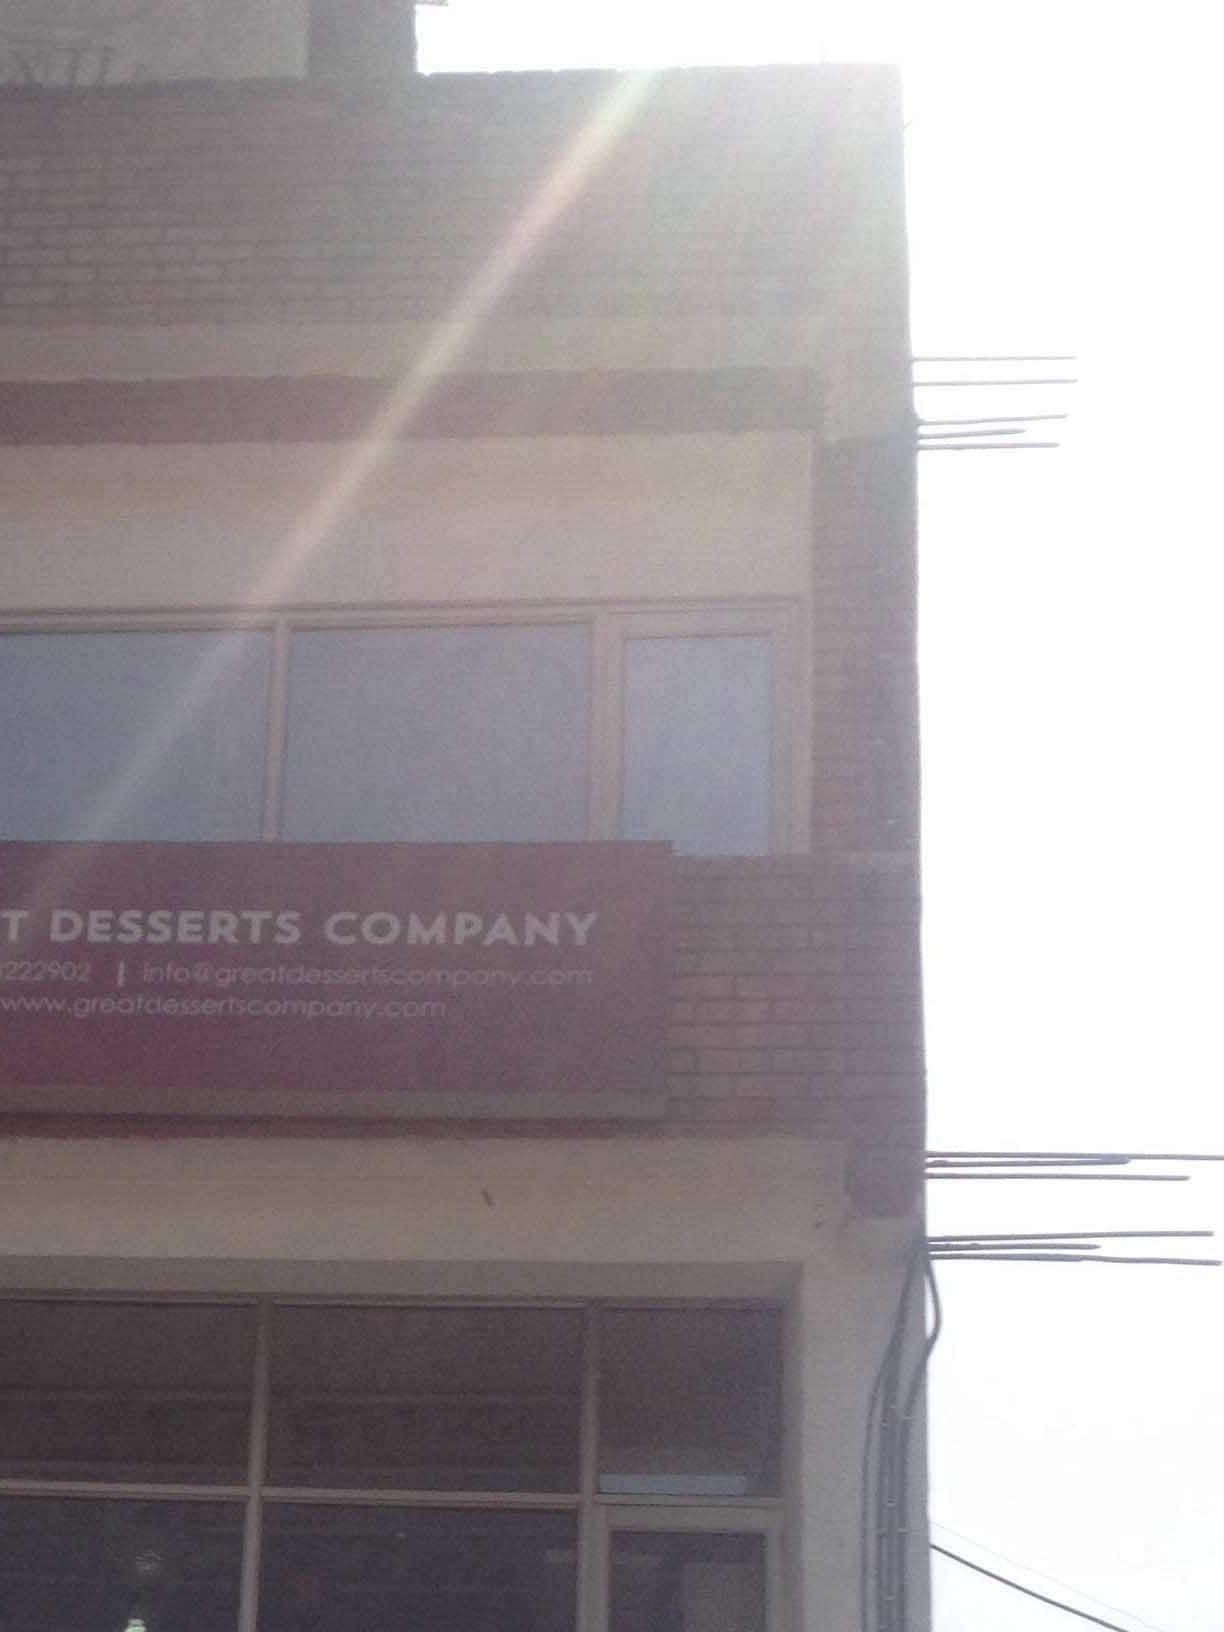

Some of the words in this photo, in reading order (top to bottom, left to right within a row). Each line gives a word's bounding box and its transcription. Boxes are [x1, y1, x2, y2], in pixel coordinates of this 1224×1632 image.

[49, 908, 301, 944] DESSERTS
[324, 911, 599, 946] COMPANY
[142, 961, 594, 987] info@greatdessertscompany.com
[0, 992, 447, 1020] www.greatdessertscompany.com
